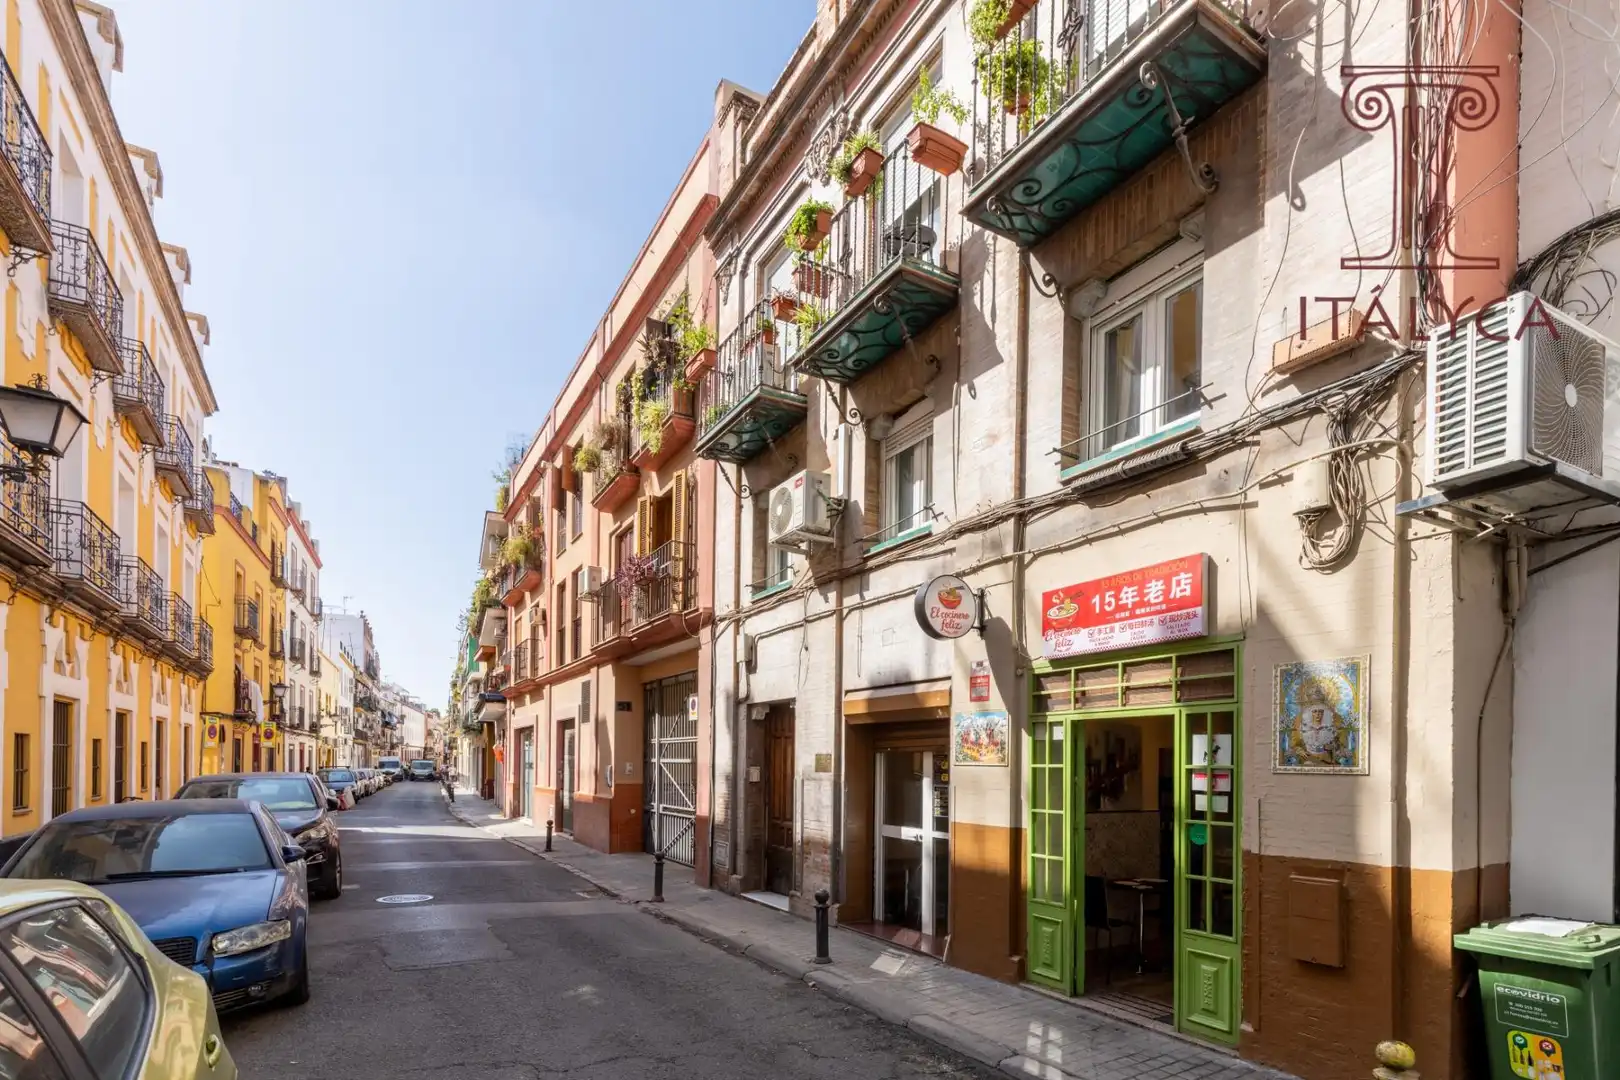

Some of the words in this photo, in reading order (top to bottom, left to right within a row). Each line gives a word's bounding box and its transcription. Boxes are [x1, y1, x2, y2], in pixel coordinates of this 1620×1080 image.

[1091, 572, 1193, 615] 15年老店
[930, 606, 940, 619] El
[940, 610, 969, 620] cocinero
[940, 618, 962, 632] feliz
[1053, 637, 1074, 652] feliz
[1496, 986, 1560, 1004] ecovidrio
